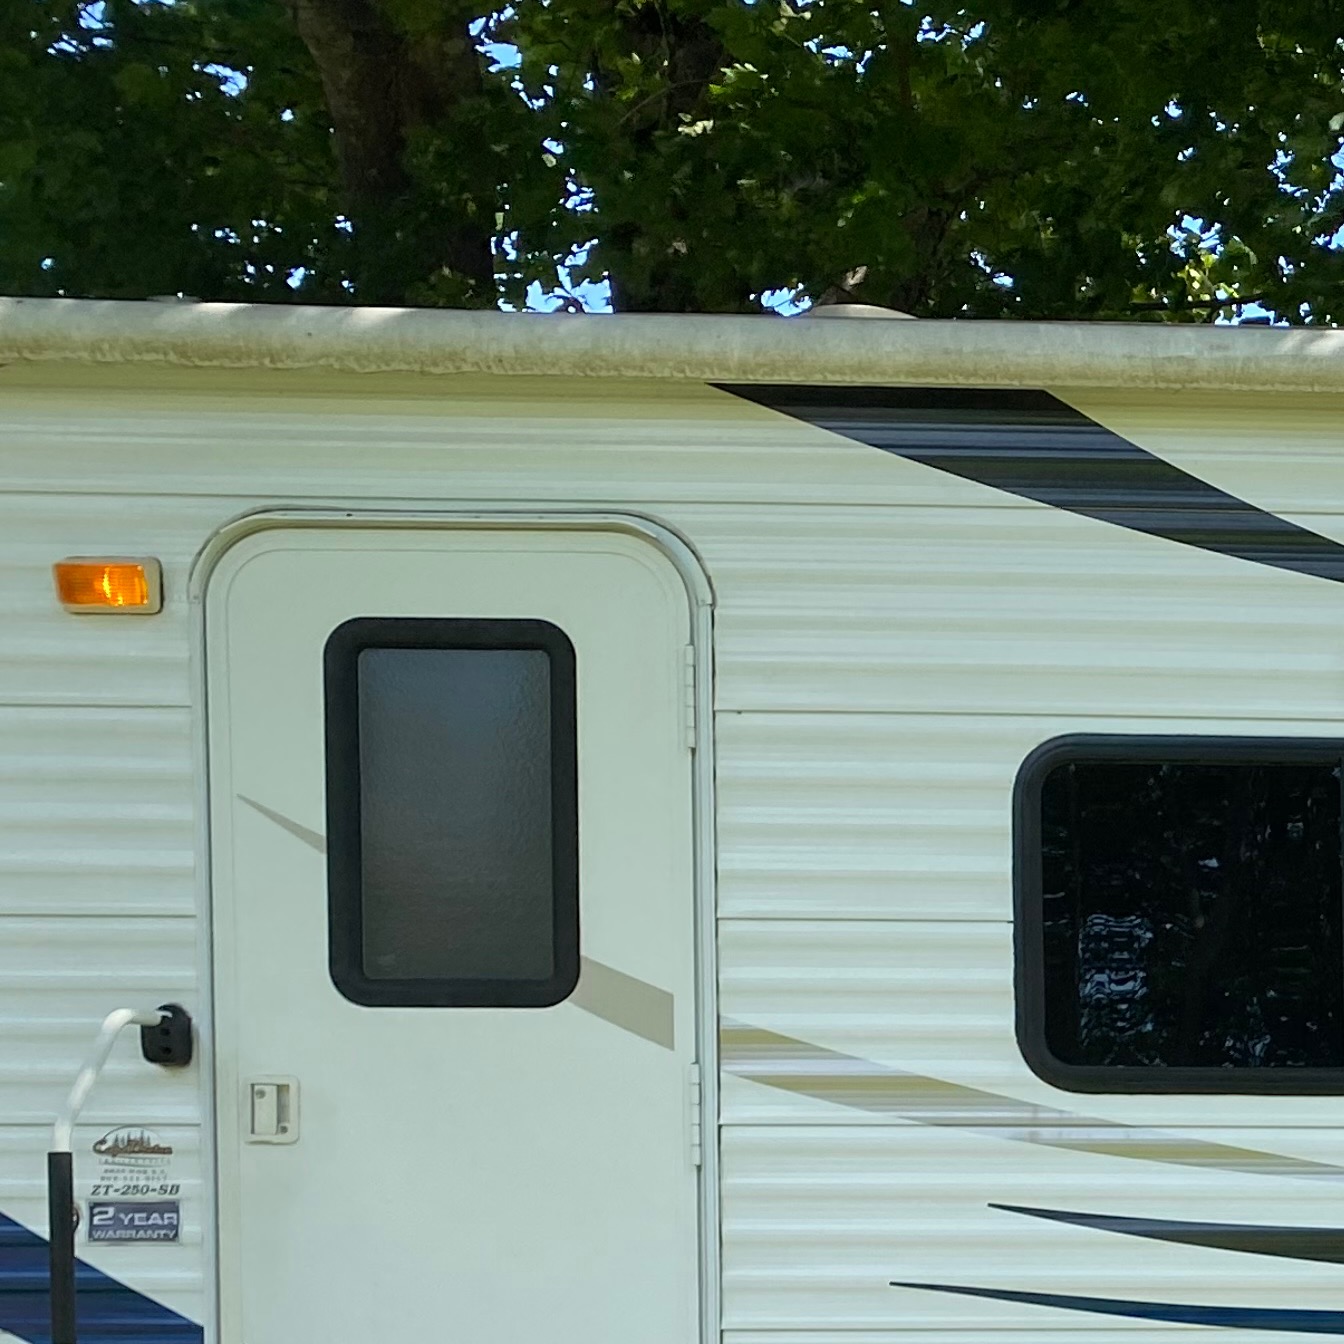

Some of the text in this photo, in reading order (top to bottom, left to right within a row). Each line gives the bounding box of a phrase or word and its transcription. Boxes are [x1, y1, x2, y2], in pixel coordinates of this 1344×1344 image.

[92, 1205, 178, 1226] 2 YEAR
[92, 1229, 176, 1239] WARRANTY
